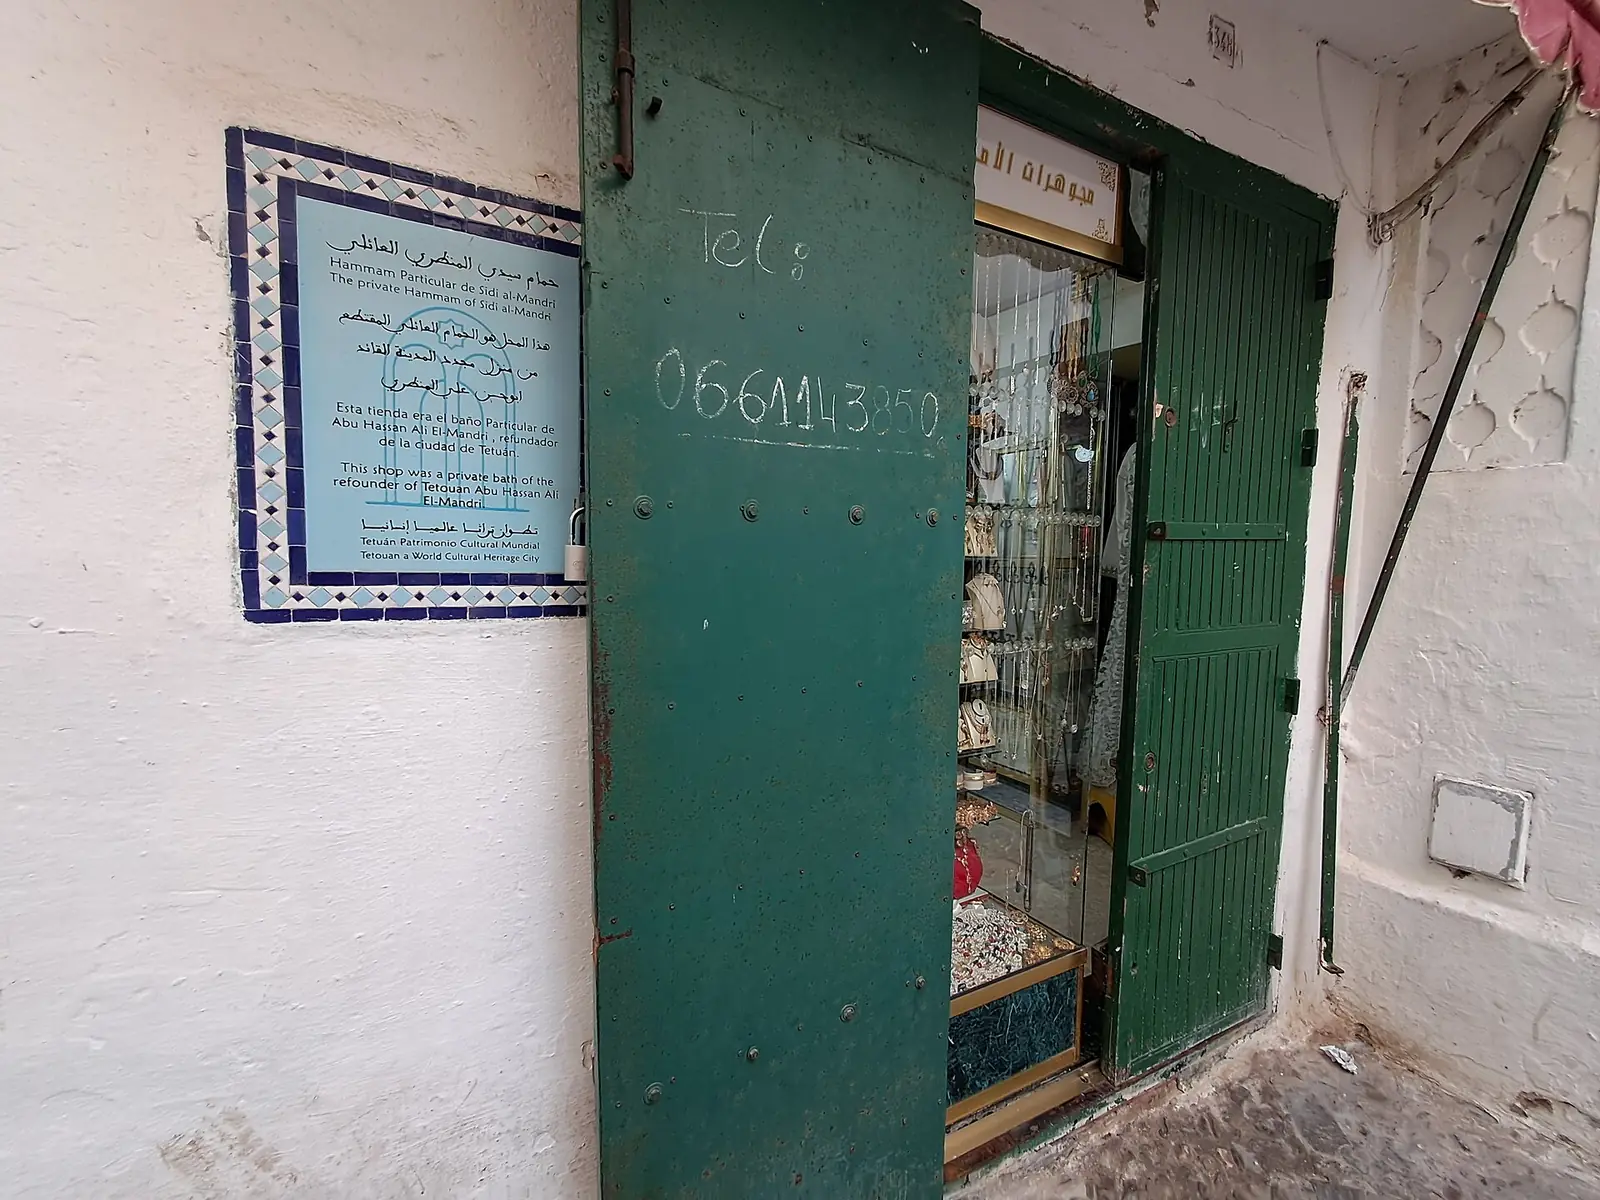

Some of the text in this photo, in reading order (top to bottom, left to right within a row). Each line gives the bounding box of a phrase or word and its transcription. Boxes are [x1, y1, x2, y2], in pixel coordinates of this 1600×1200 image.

[976, 140, 1095, 207] مجوهرات الأم
[325, 233, 559, 290] حمام سيدي المنظري العائلي
[330, 256, 556, 309] Hammam Particular de Sidi al-Mandri
[329, 271, 551, 321] The private Hammam of Sidi al-Mandri
[443, 325, 479, 342] الحمام
[478, 333, 497, 346] هو
[491, 332, 528, 350] المحل
[394, 345, 436, 362] المدينة
[532, 338, 551, 351] هذا
[478, 357, 513, 377] منزل
[516, 368, 539, 381] من
[380, 376, 439, 393] المنظري
[654, 345, 941, 439] 0661143850
[336, 401, 556, 435] Esta tienda era el baño Particular de
[331, 416, 359, 429] Abu
[363, 420, 408, 433] Hassan
[411, 425, 428, 436] Ali
[432, 426, 489, 441] El-Mandri
[499, 433, 560, 448] refundador
[378, 436, 520, 459] de la ciudad de Tetuán.
[340, 461, 555, 487] This shop was a private bath of the
[332, 476, 560, 500] refounder of Tetouan Abu Hassan Ali
[423, 496, 486, 509] El-Mandri.
[413, 520, 459, 534] عالميا
[360, 536, 541, 551] Tetuán Patrimonio Cultural Mundial
[360, 550, 541, 564] Tetouan a World Cultural Heritage City
